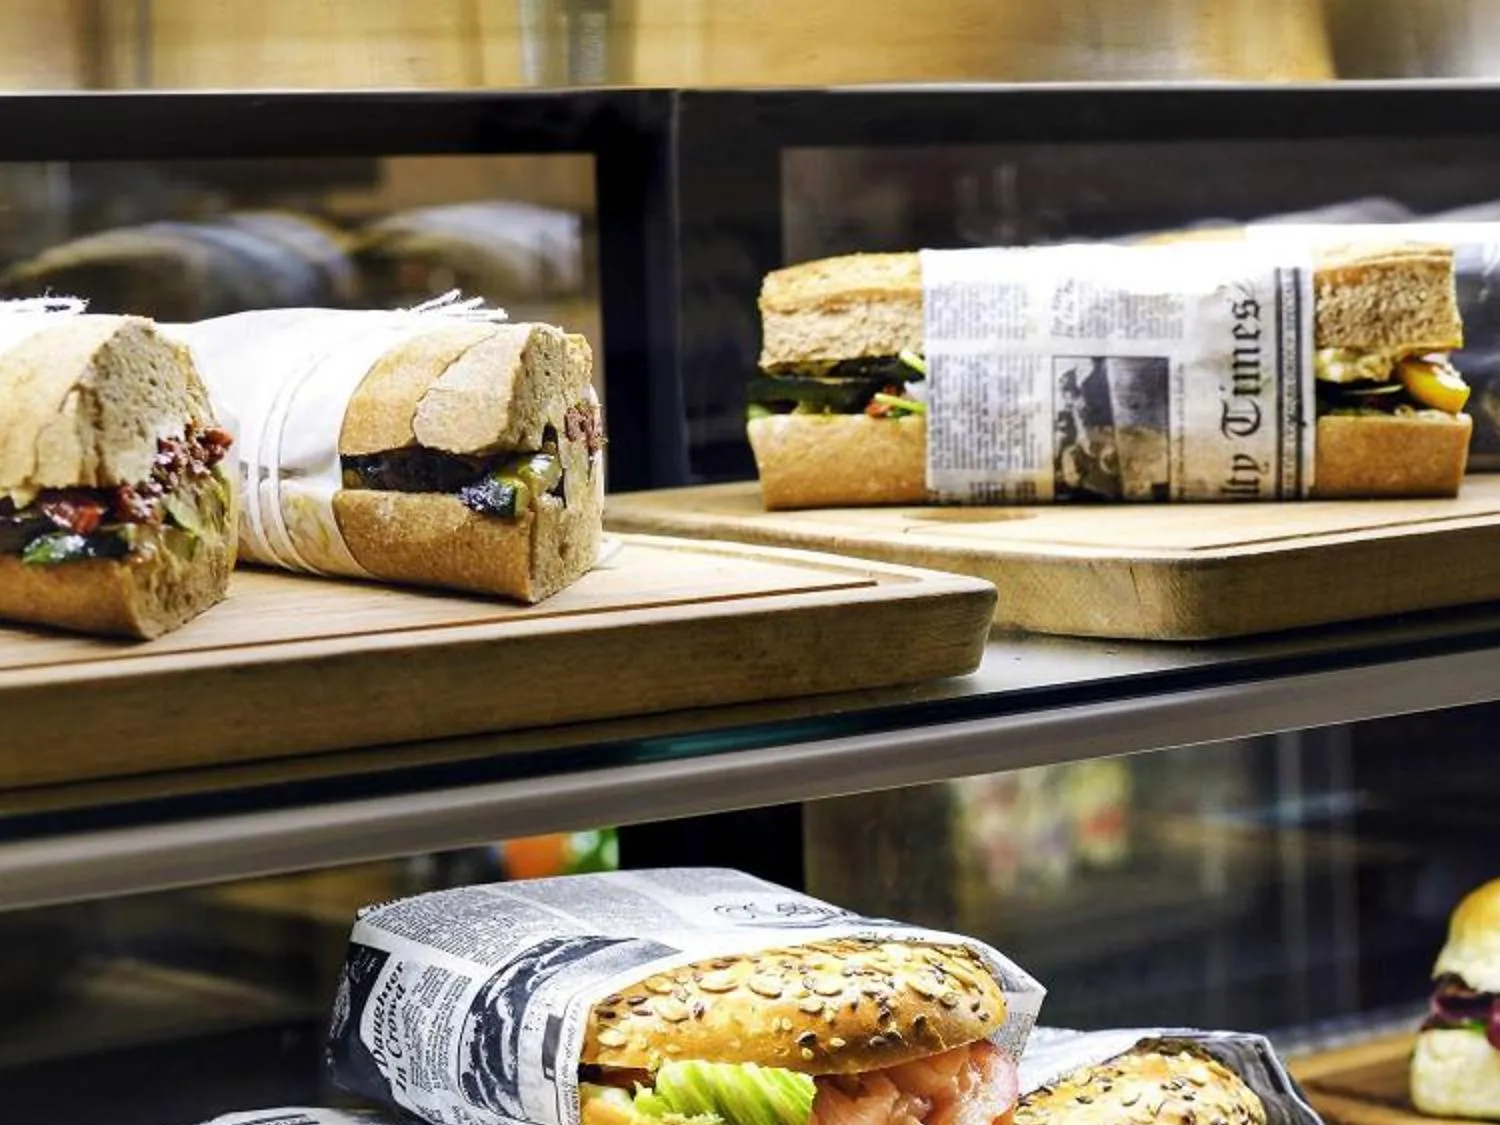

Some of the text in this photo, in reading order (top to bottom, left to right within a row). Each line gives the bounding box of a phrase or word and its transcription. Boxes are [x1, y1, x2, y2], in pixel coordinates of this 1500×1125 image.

[1219, 299, 1262, 440] Times
[371, 961, 404, 1068] Daughter
[385, 983, 407, 1059] Crowd
